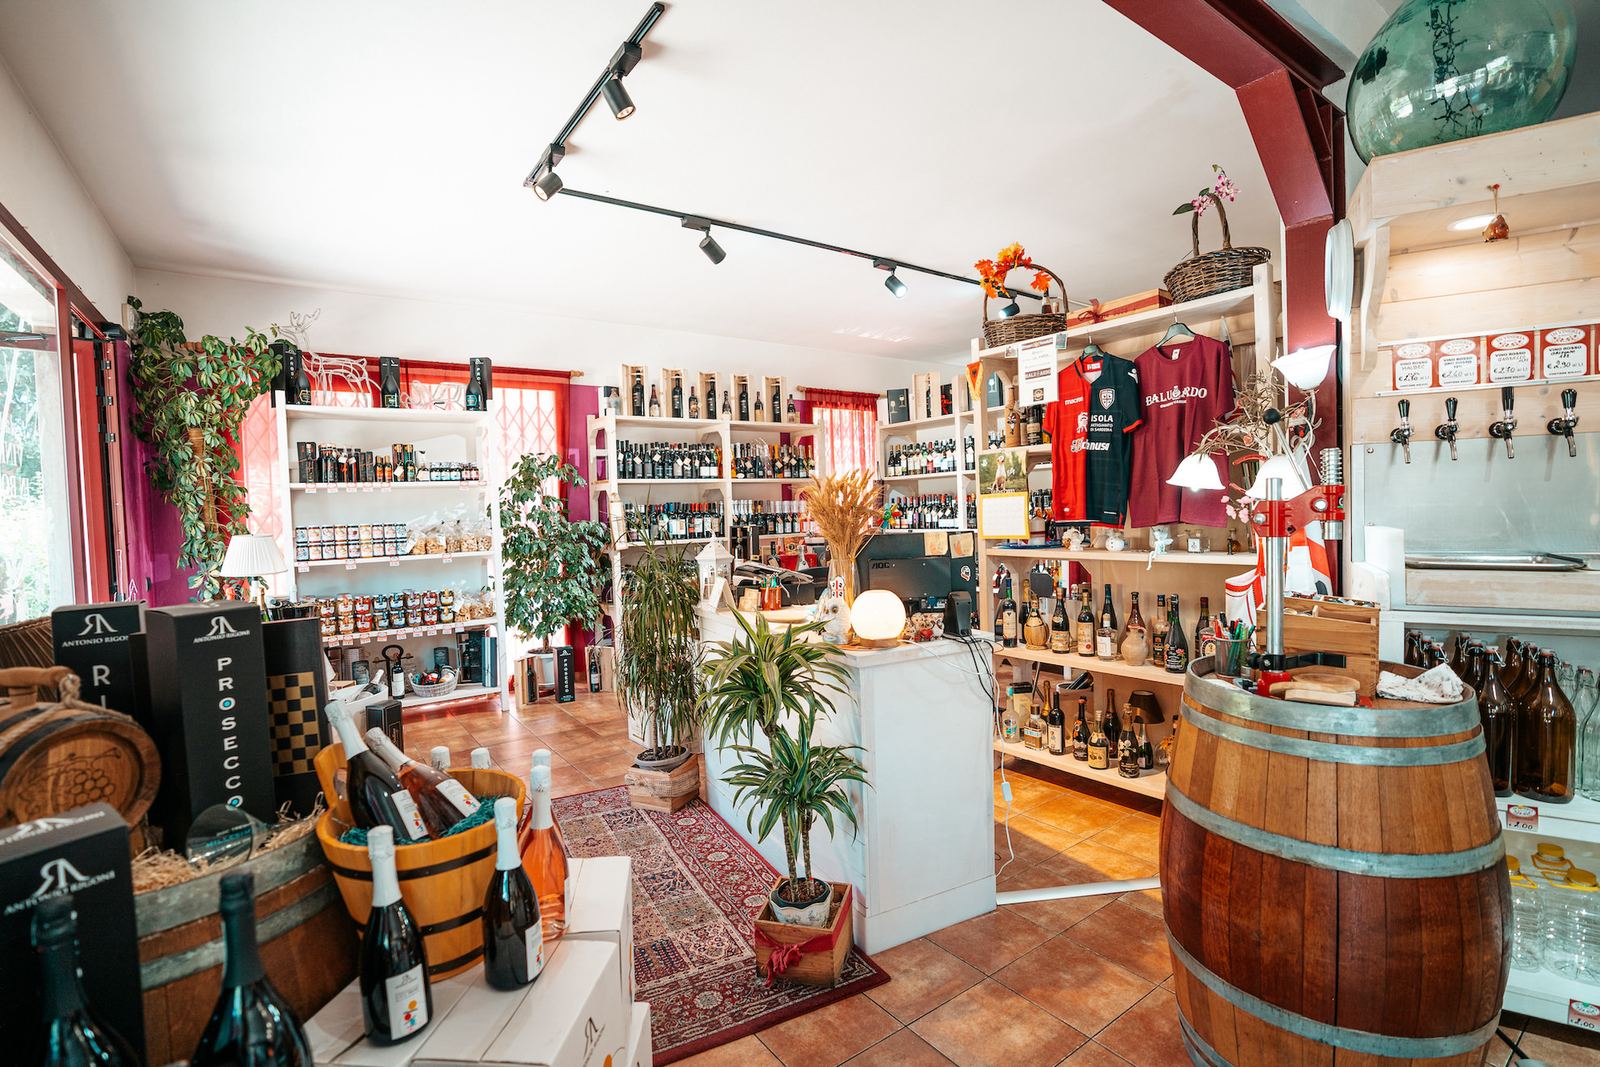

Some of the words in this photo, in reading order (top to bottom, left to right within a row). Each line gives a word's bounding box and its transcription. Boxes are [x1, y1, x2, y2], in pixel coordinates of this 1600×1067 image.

[1091, 414, 1113, 422] ISOLA
[62, 637, 103, 648] ANTONIO
[217, 657, 244, 811] PROSECCO
